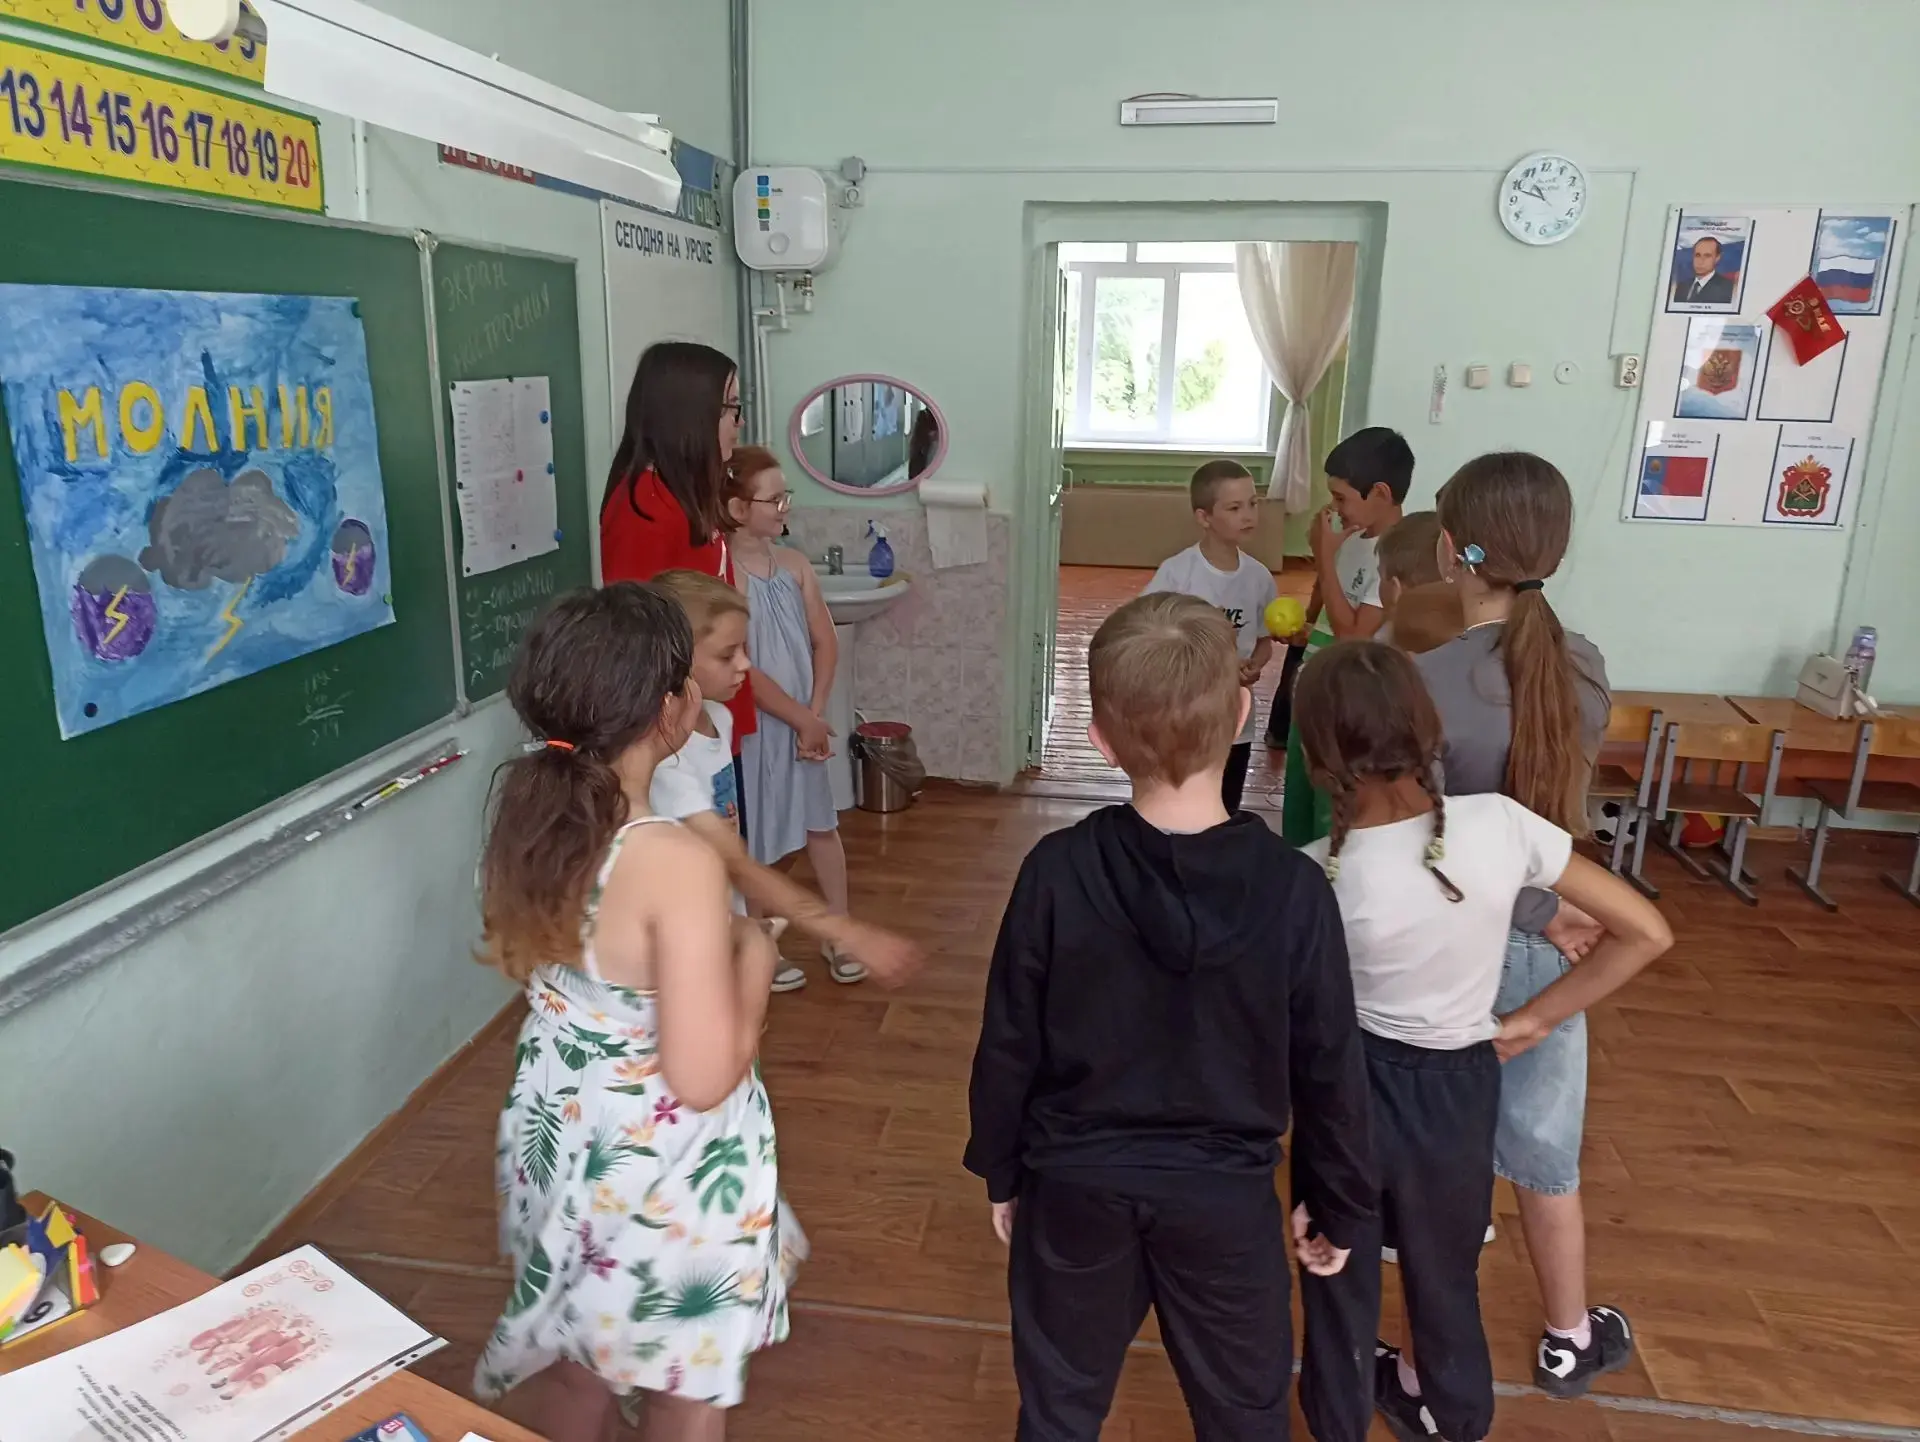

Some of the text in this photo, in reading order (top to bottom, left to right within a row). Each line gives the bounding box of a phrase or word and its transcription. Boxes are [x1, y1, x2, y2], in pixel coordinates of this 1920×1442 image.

[1, 69, 310, 188] 13 14 15 16 17 18 19 20
[615, 220, 713, 264] СЕГОДНЯ НА УРОКЕ
[58, 381, 334, 462] МОЛНИЯ
